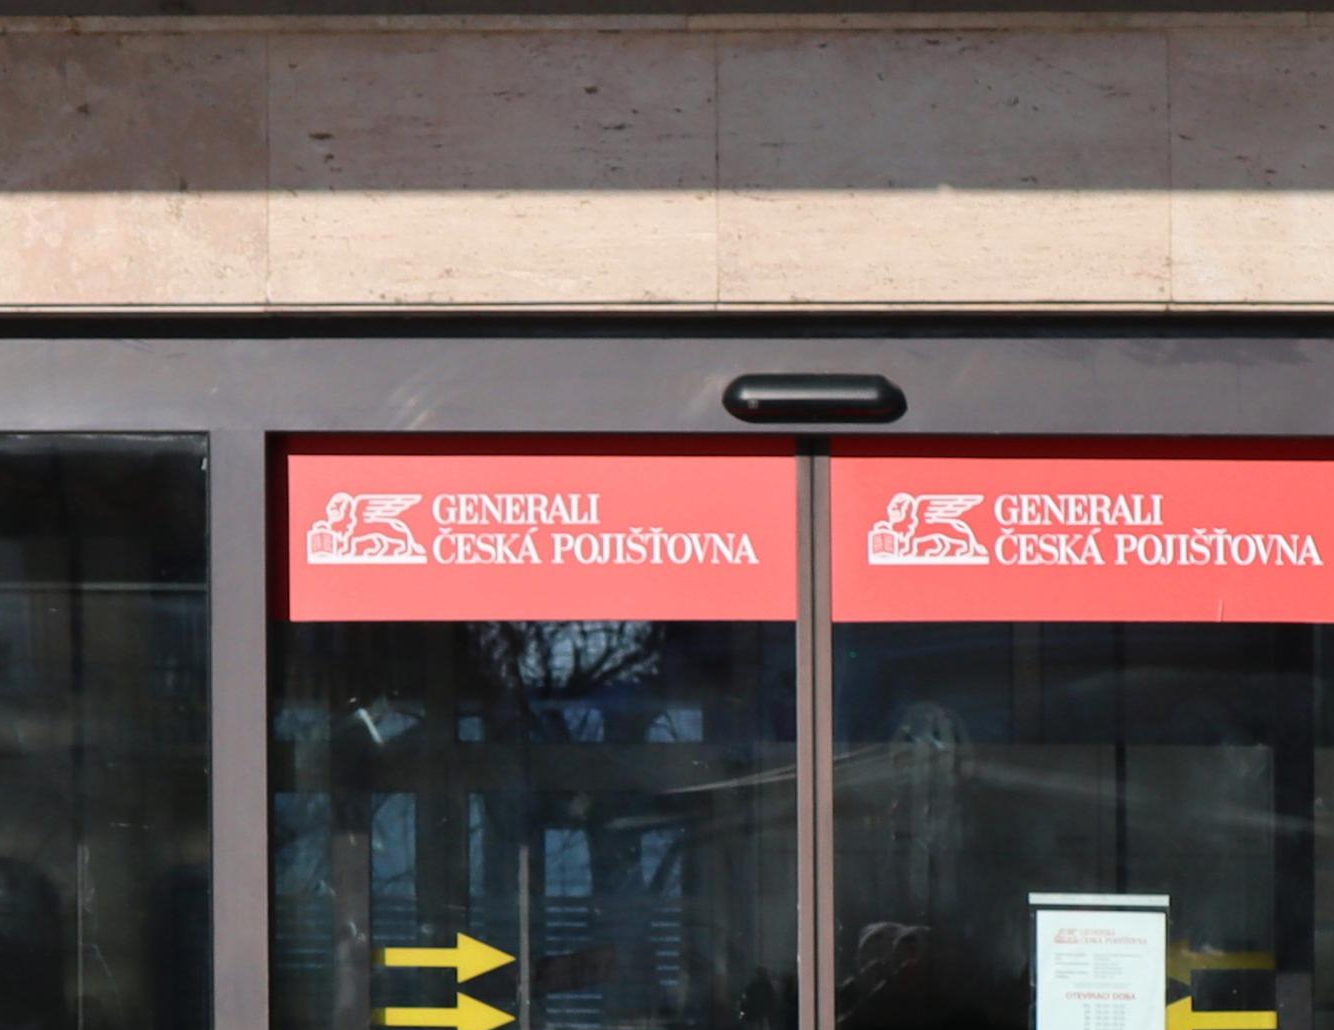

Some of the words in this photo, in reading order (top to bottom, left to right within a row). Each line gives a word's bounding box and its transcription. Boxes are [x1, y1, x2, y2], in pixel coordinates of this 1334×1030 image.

[432, 493, 601, 525] GENERALI
[993, 494, 1163, 526] GENERALI
[432, 527, 542, 565] ČESKÁ
[551, 527, 759, 565] POJIŠŤOVNA
[994, 528, 1105, 566] ČESKÁ
[1114, 528, 1324, 567] POJIŠŤOVNA
